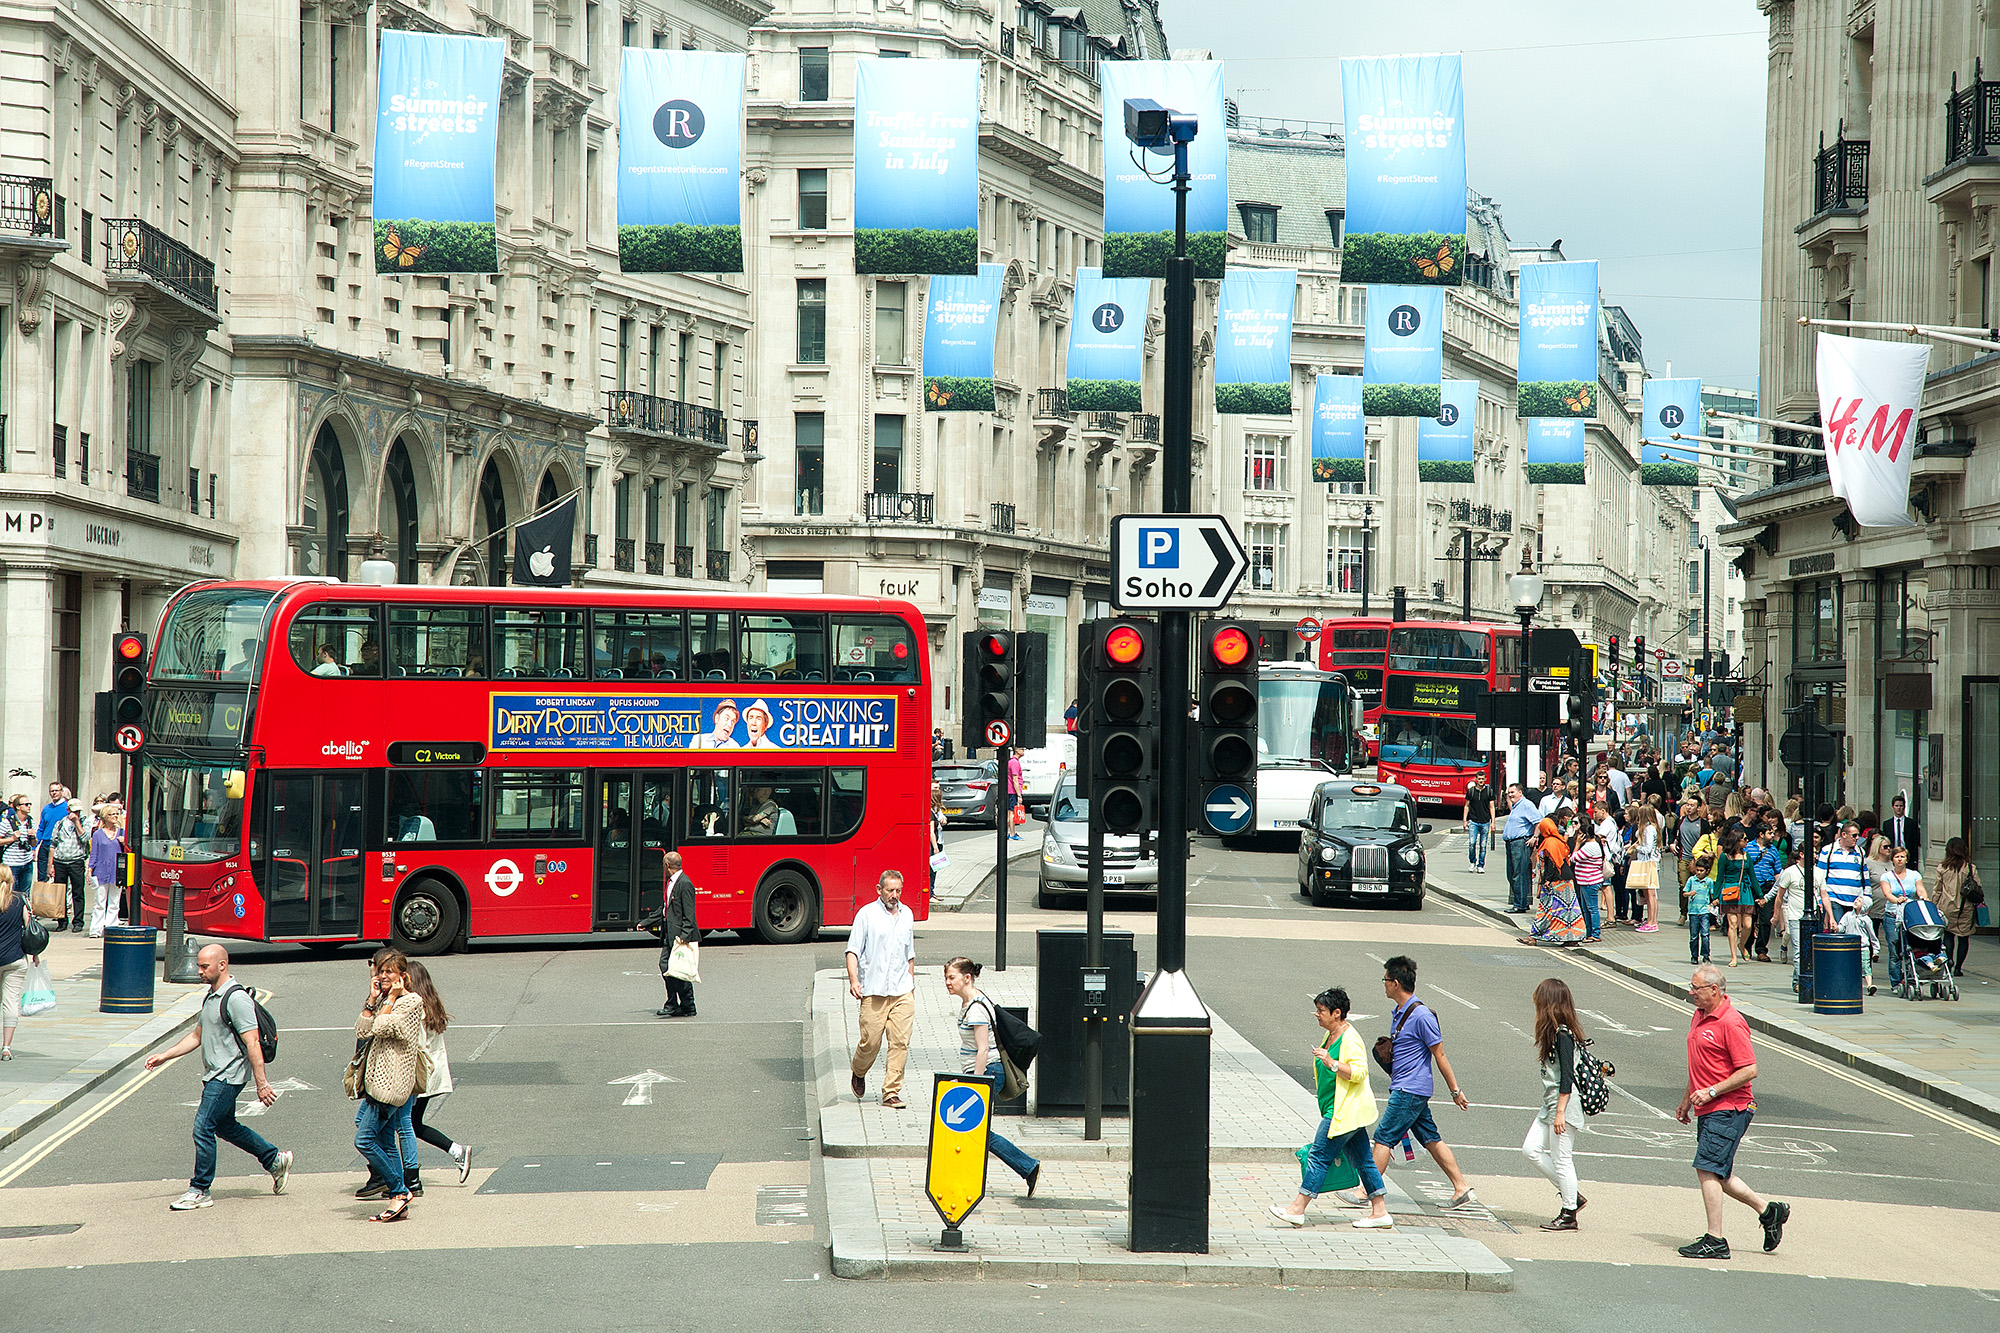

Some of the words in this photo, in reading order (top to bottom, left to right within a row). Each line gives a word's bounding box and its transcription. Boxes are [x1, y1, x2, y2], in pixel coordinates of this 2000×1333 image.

[390, 92, 487, 117] Summer
[396, 113, 478, 134] streets
[665, 108, 696, 138] R
[866, 109, 926, 131] Traffic
[929, 111, 970, 129] Free
[1358, 114, 1455, 132] Summer
[879, 131, 956, 153] Sundays
[1366, 131, 1447, 149] streets
[404, 157, 465, 171] #RegentStreet
[628, 163, 728, 178] regentstreetonline.com
[886, 152, 905, 170] in
[908, 151, 949, 175] July
[1377, 174, 1438, 185] #RegentStreet
[935, 300, 992, 314] Summer
[1224, 307, 1258, 322] Traffic
[1264, 308, 1288, 321] Free
[1527, 303, 1591, 316] Summer
[937, 313, 985, 325] streets
[1100, 308, 1118, 328] R
[1397, 311, 1415, 330] R
[1531, 315, 1585, 328] streets
[1231, 322, 1279, 335] Sundays
[1235, 334, 1247, 346] in
[1249, 334, 1273, 349] July
[1319, 402, 1361, 412] Summer
[1441, 407, 1455, 422] R
[1321, 410, 1357, 420] streets
[1666, 409, 1680, 424] R
[1542, 427, 1551, 436] in
[1552, 427, 1572, 438] July
[1825, 396, 1914, 463] H&M
[774, 527, 804, 535] PRINCES
[807, 527, 832, 535] STREET
[1147, 531, 1172, 565] P
[879, 578, 917, 597] fcuk
[1125, 576, 1193, 598] Soho
[1355, 670, 1368, 680] 453
[1446, 685, 1459, 695] 94
[1413, 696, 1439, 706] Piccadilly
[1440, 697, 1458, 705] Circus
[168, 708, 202, 724] Victoria
[497, 708, 546, 734] DIRTY
[545, 708, 605, 737] ROTTEN
[608, 707, 702, 734] SCOUNDRELS
[624, 735, 640, 747] THE
[642, 735, 684, 747] MUSICAL
[779, 723, 845, 746] GREAT
[321, 740, 364, 755] abellio
[415, 750, 431, 762] C2
[434, 751, 461, 760] Victoria
[171, 848, 182, 858] 403
